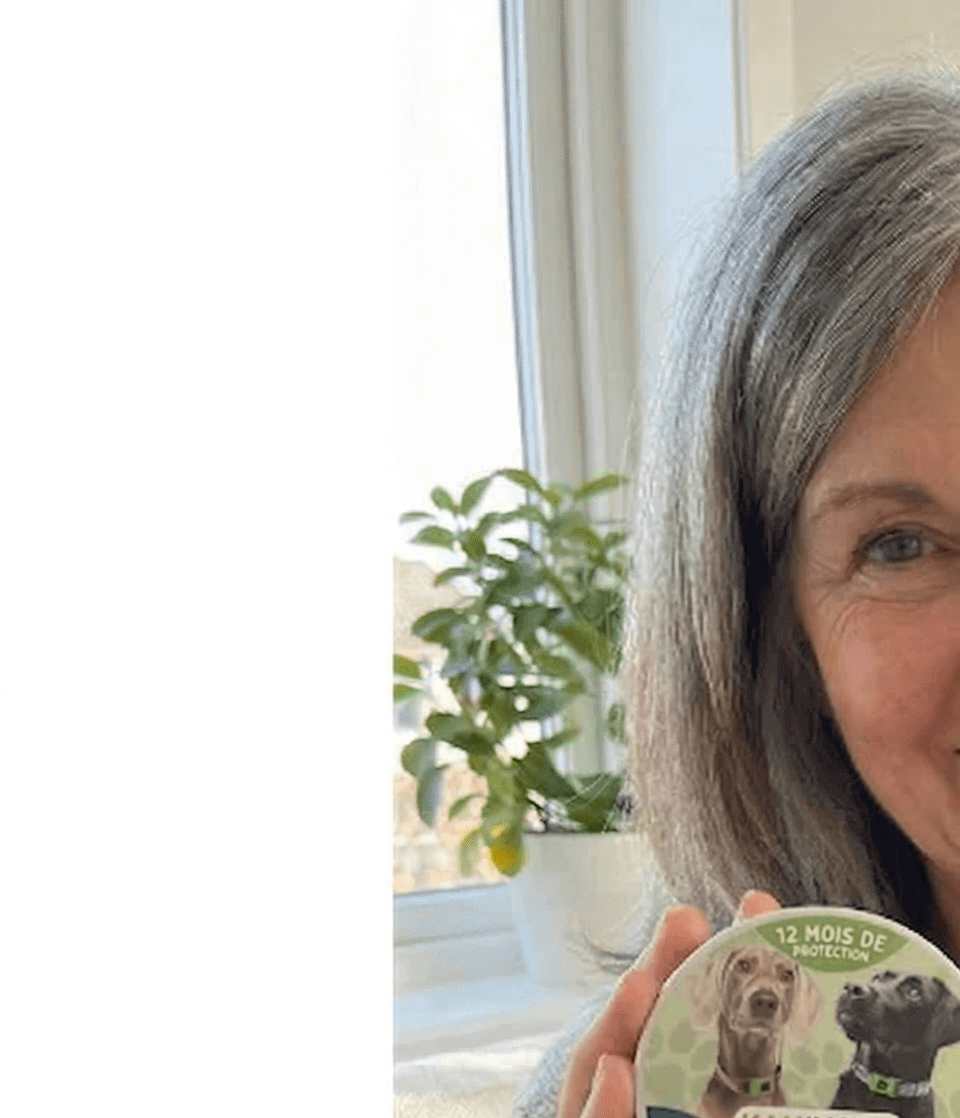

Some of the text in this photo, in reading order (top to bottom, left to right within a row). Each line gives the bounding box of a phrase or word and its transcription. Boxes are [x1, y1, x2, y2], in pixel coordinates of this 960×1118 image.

[776, 924, 887, 952] 12 MOIS DE
[793, 944, 869, 962] PROTECTION
